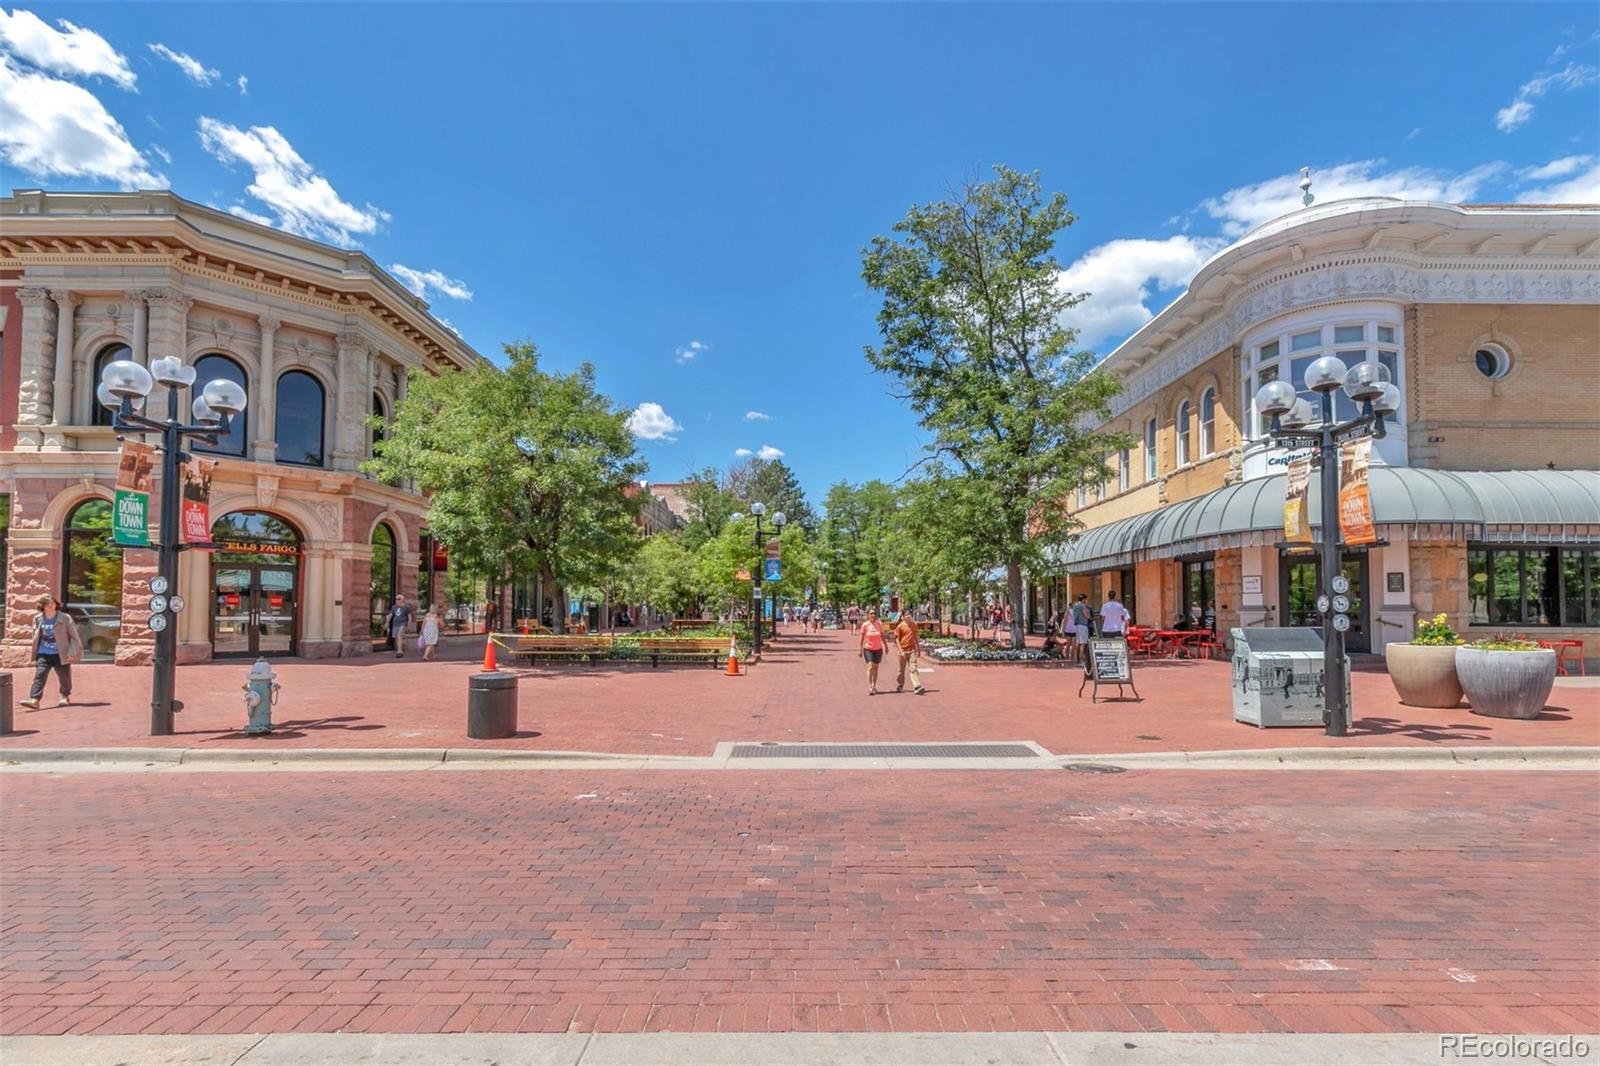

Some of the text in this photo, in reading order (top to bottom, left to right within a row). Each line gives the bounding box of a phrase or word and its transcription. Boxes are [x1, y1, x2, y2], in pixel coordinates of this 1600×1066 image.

[1295, 439, 1314, 447] STREET
[119, 500, 143, 515] DOWN
[120, 514, 143, 528] TOWN
[186, 511, 205, 524] DOWN
[187, 523, 207, 537] TOWN
[226, 542, 297, 553] ELLS FARGO
